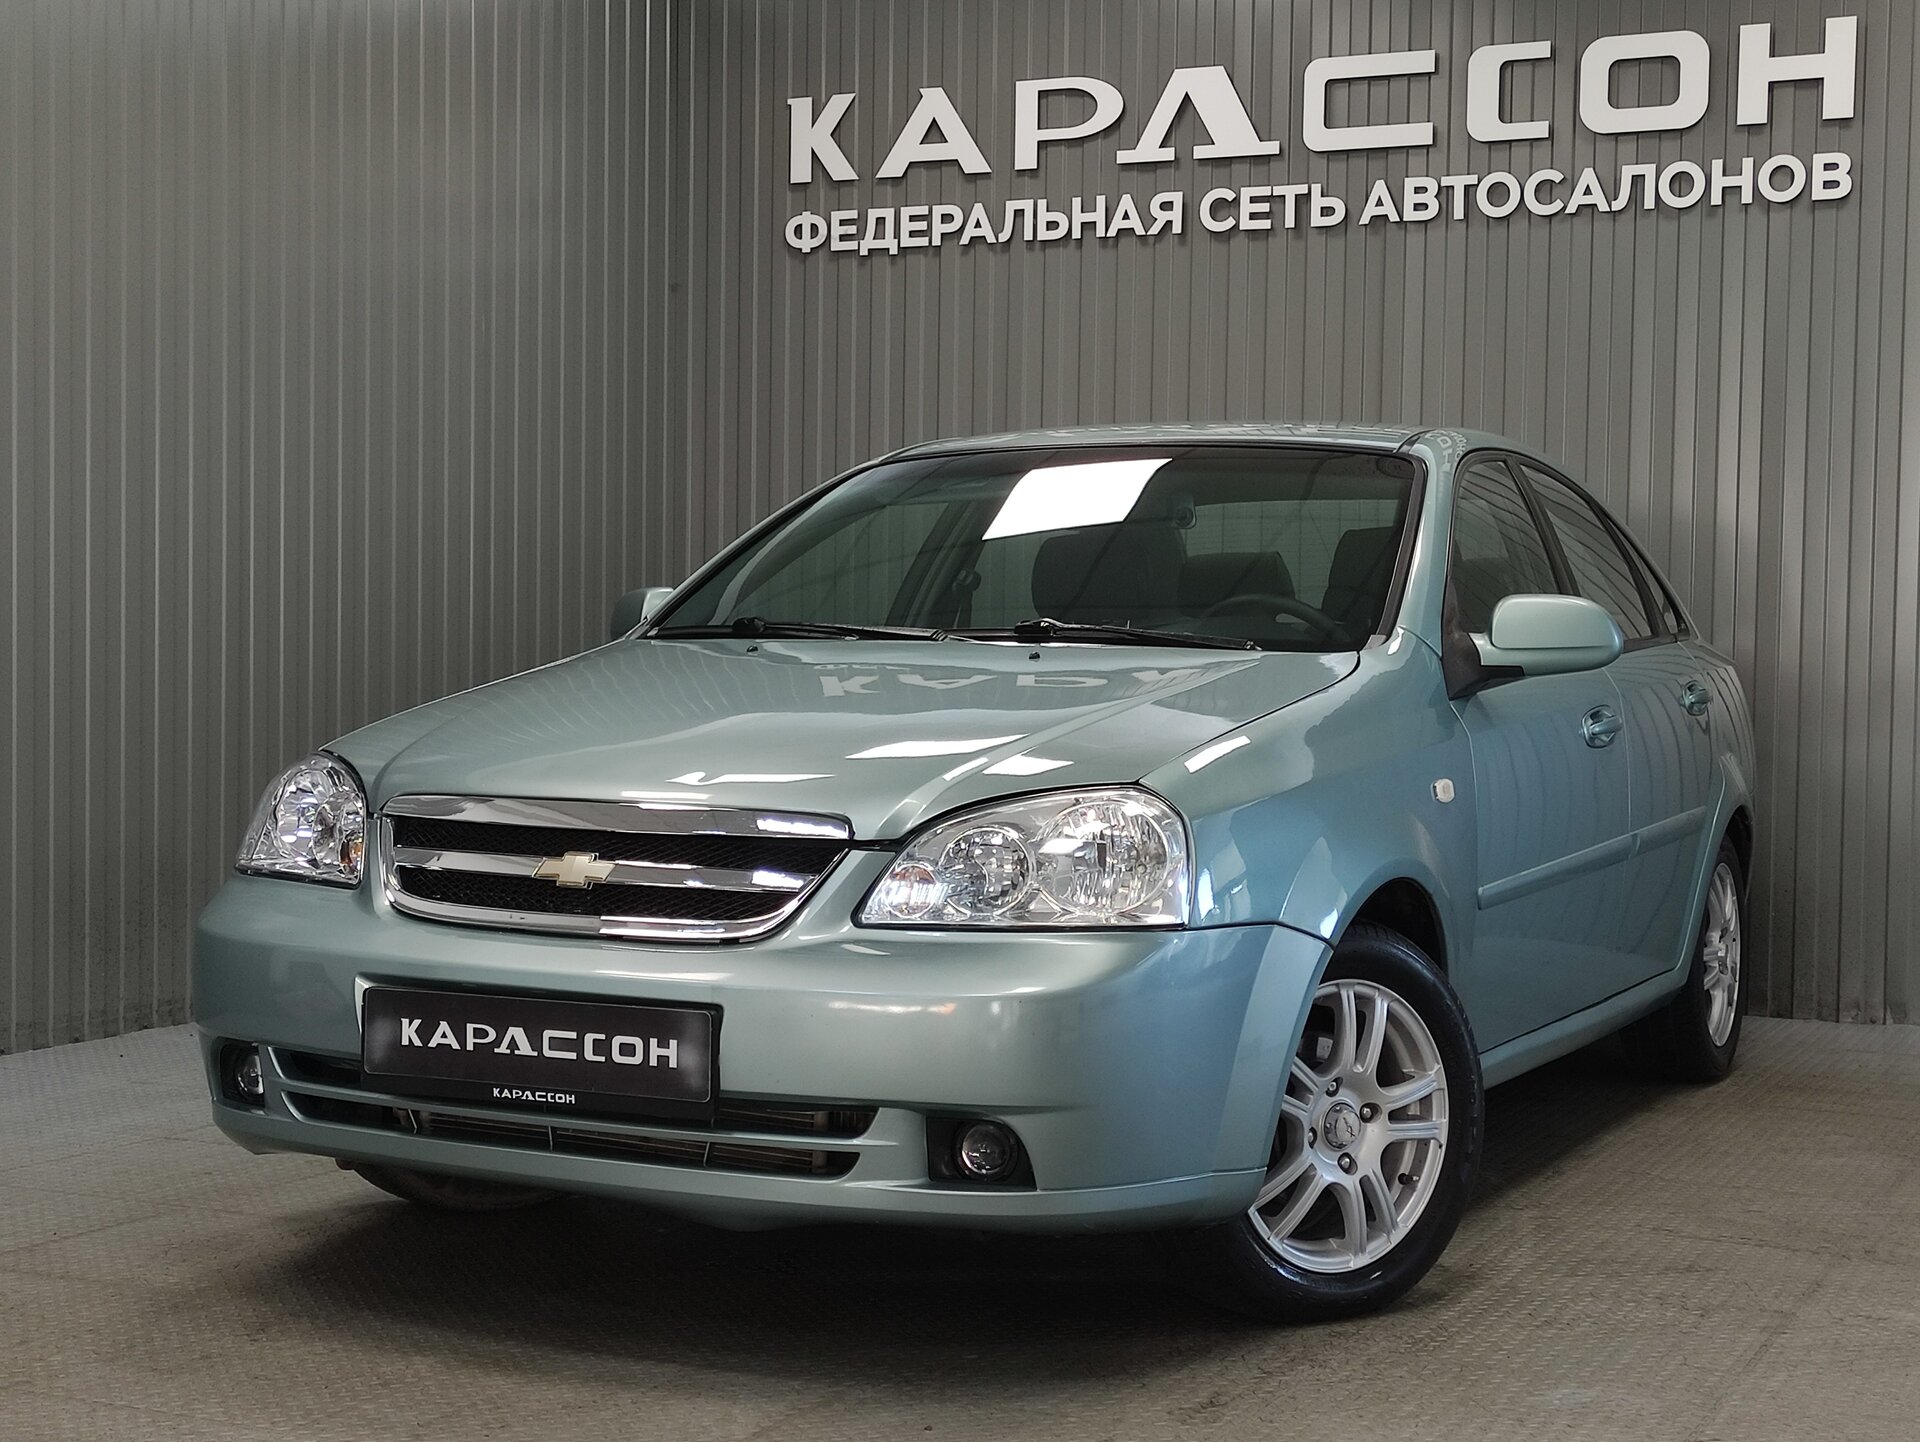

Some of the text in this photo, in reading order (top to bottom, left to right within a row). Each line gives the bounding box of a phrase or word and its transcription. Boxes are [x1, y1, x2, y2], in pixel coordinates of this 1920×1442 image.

[784, 151, 1853, 257] ФЕДЕРАЛЬНАЯ СЕТЬ АВТОСАЛОНОВ
